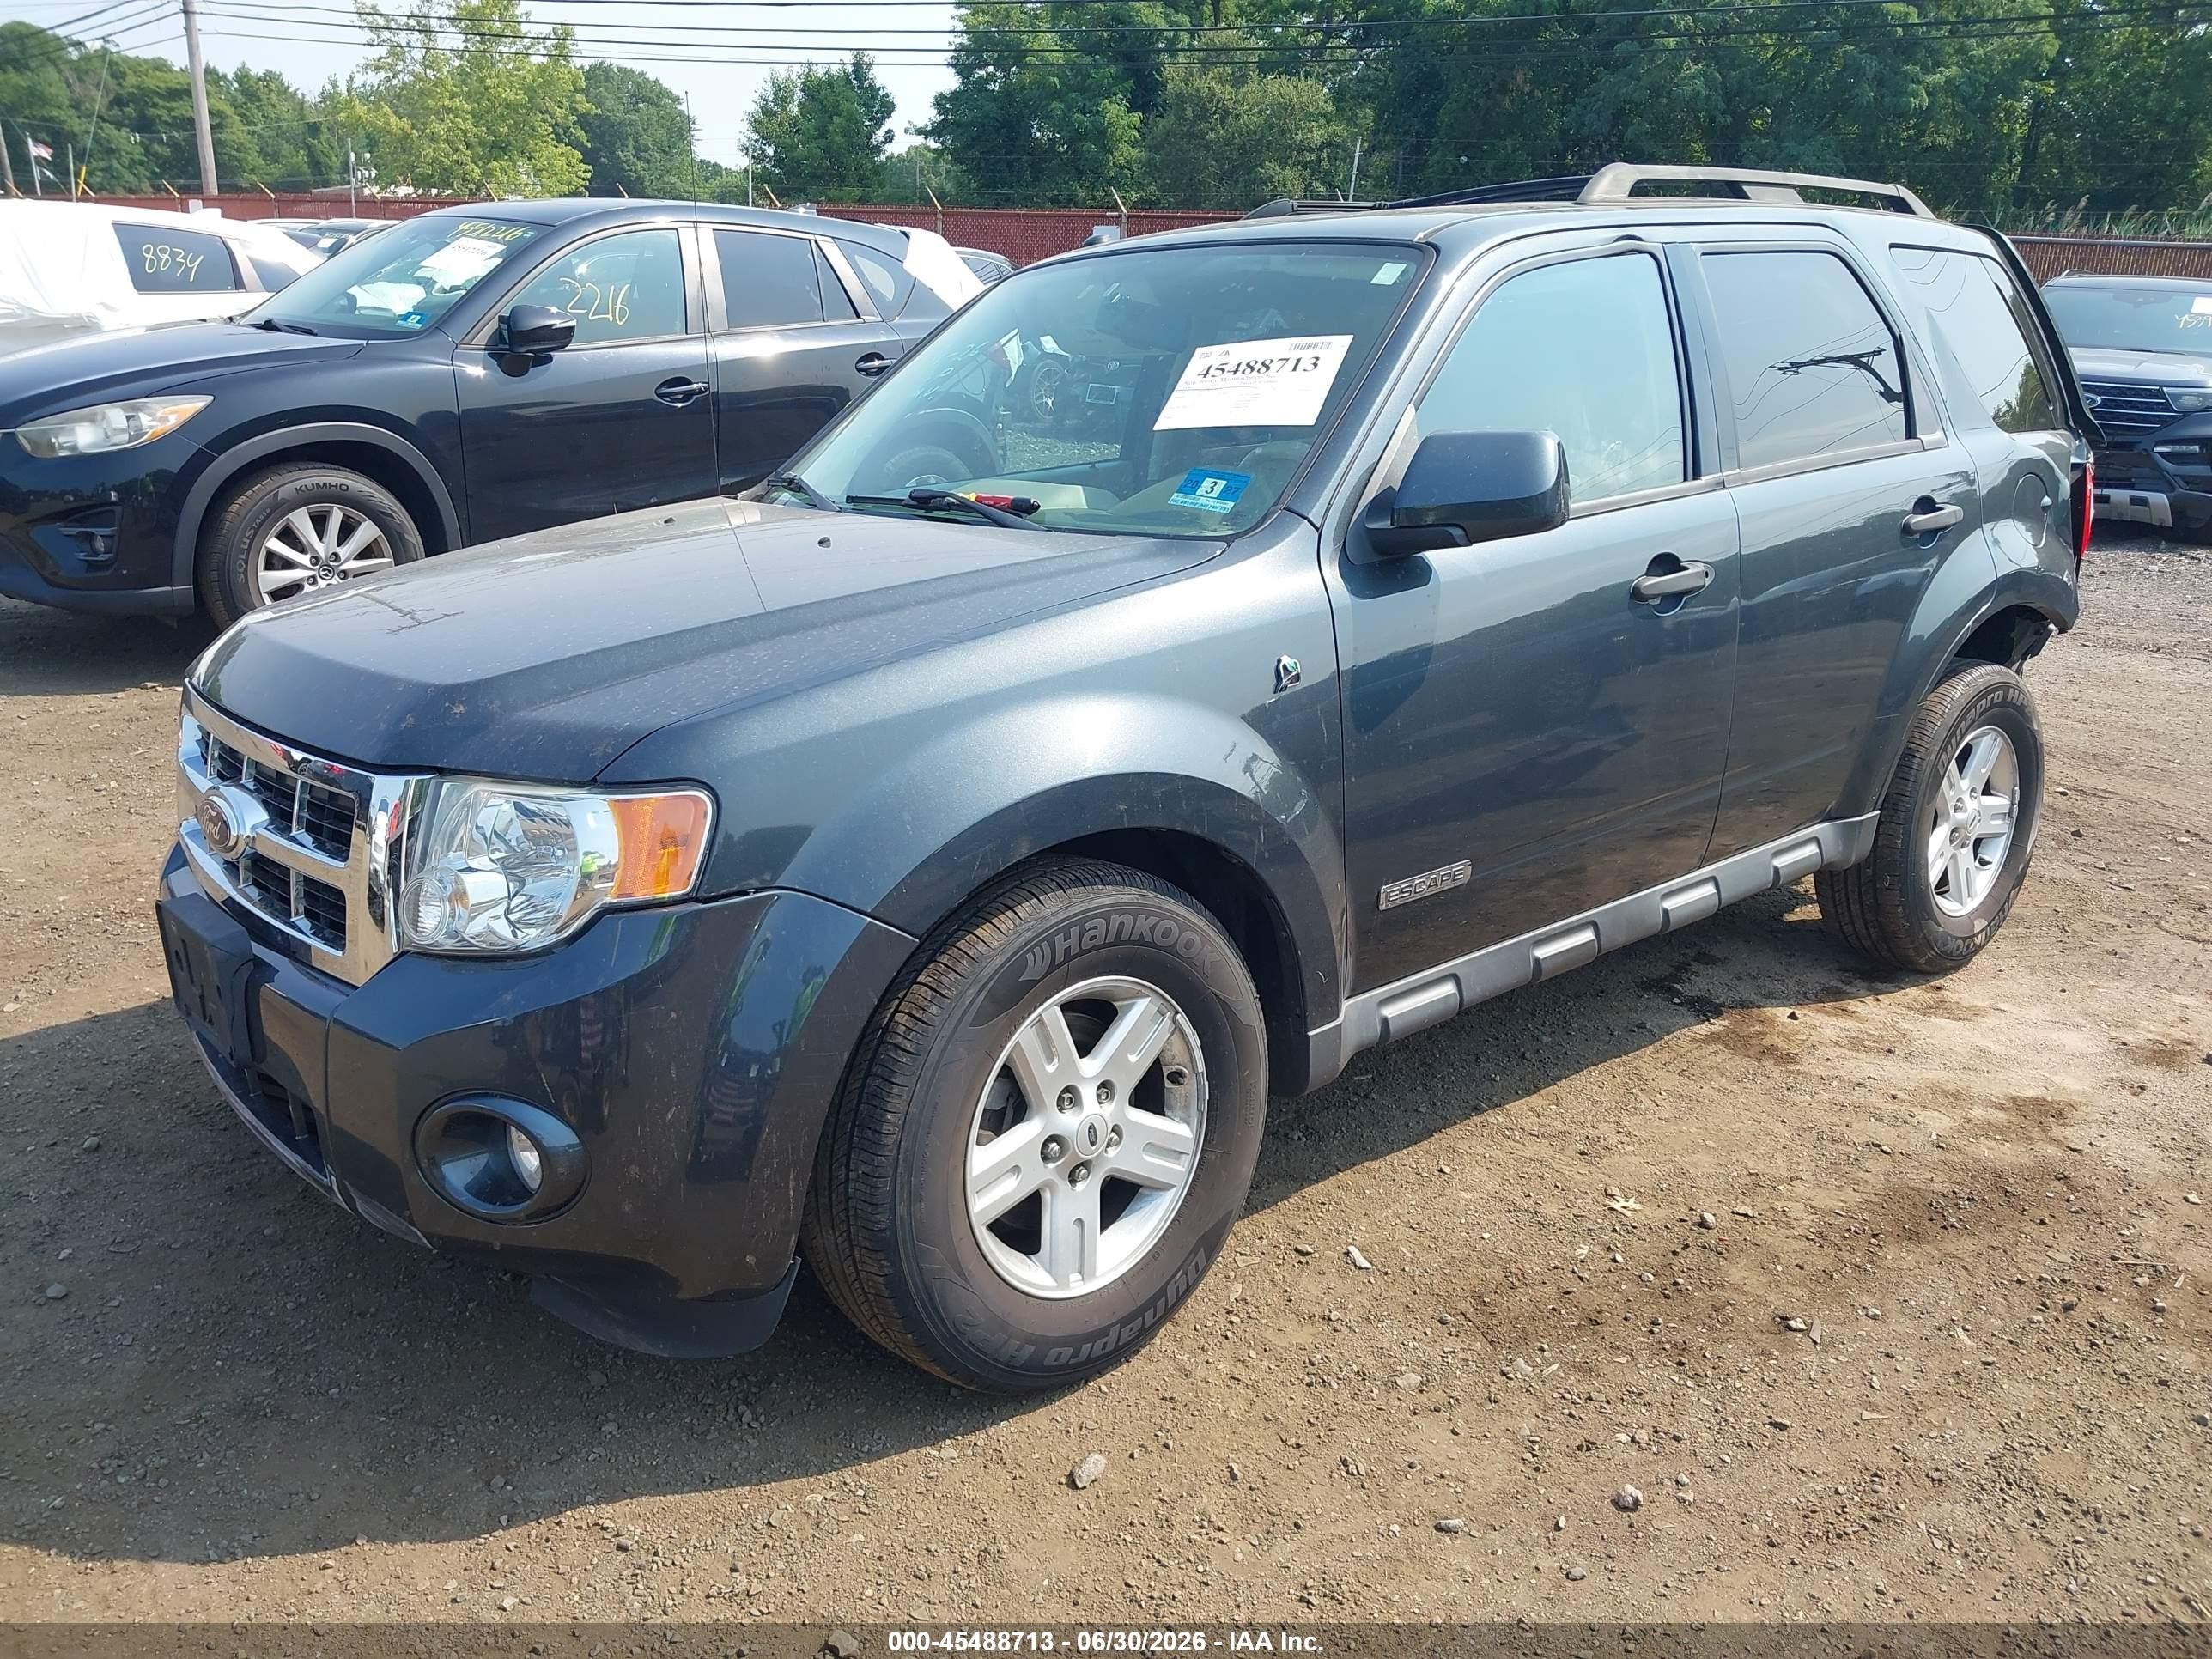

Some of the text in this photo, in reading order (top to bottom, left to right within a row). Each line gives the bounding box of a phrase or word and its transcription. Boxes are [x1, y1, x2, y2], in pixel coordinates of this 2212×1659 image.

[143, 244, 204, 283] 8834
[560, 277, 630, 325] 2216
[1197, 356, 1321, 378] 45488713
[295, 482, 349, 495] KUMHO
[1205, 481, 1218, 494] 3
[236, 526, 255, 584] SOLUS
[202, 804, 221, 841] Ford
[1387, 865, 1465, 903] ESCAPE
[1054, 914, 1223, 978] Hankook
[1043, 1247, 1207, 1367] Dynapro
